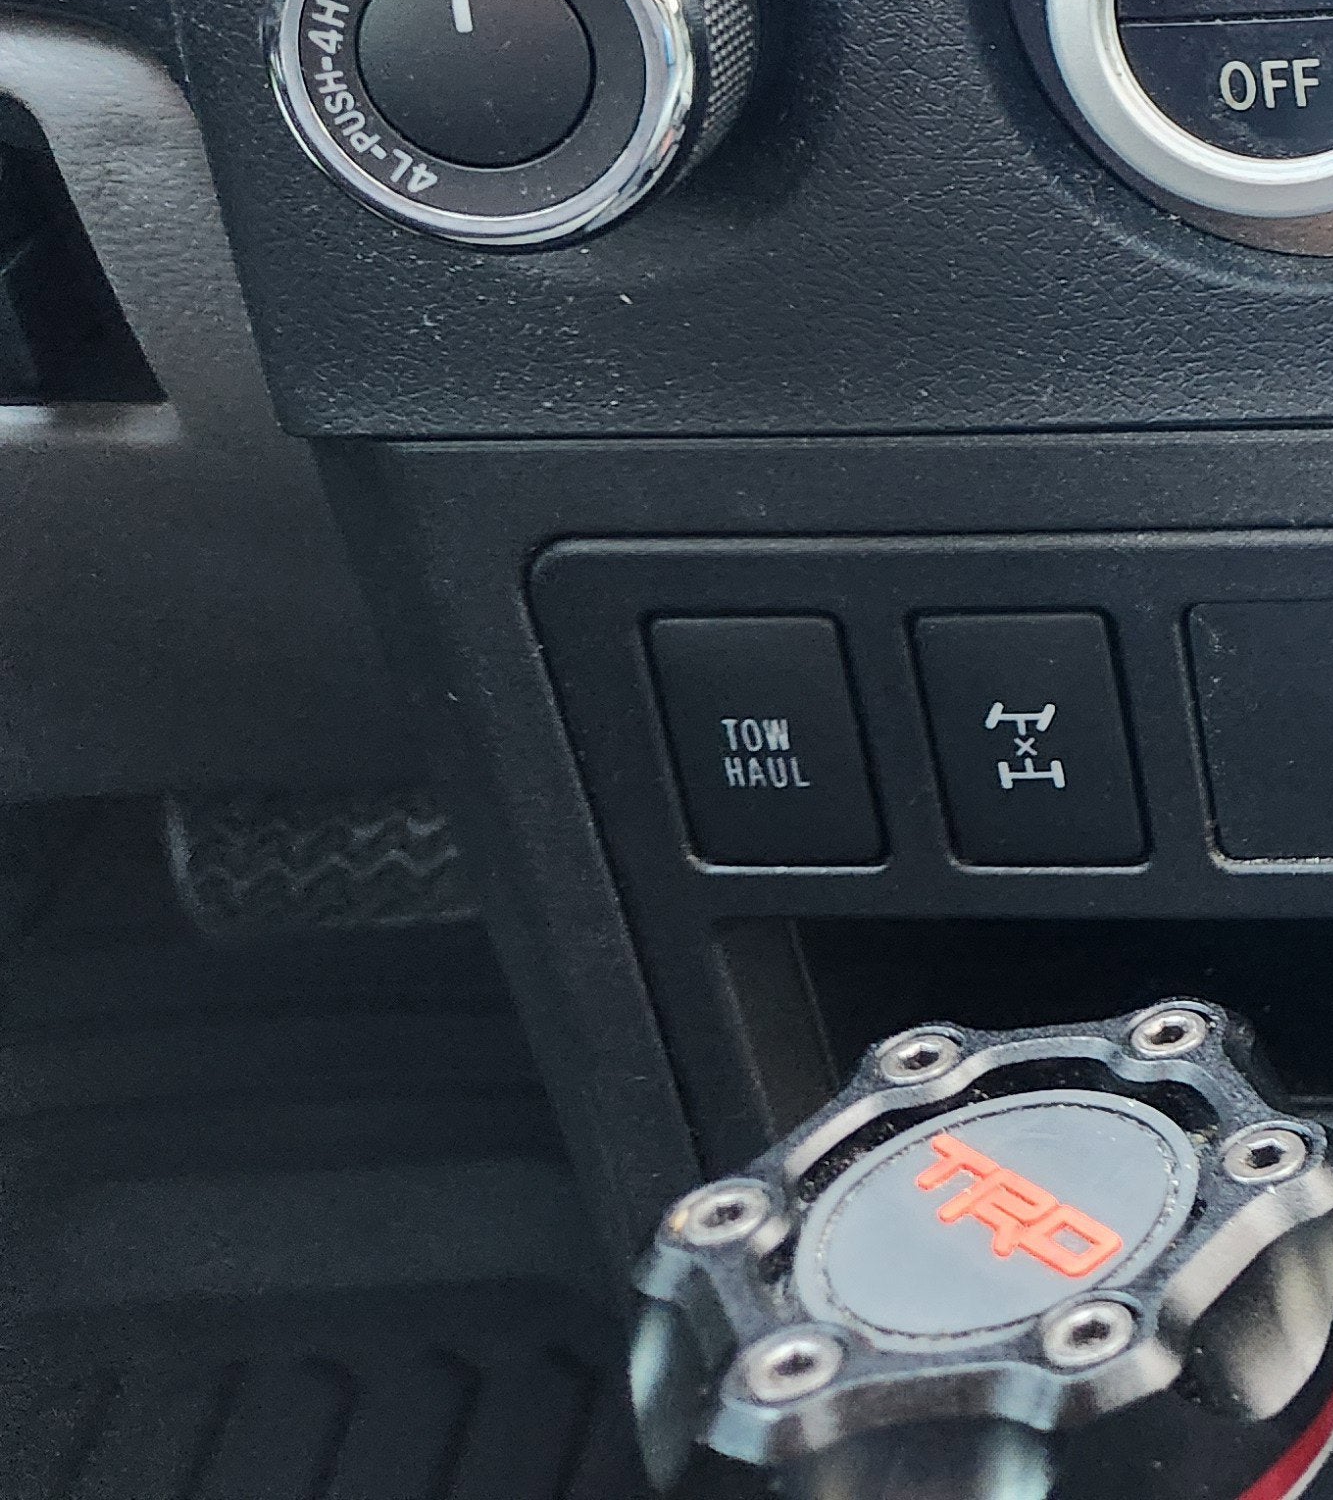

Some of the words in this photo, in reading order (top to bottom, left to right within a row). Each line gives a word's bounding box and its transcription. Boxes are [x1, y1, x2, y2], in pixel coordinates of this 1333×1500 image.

[1219, 58, 1320, 111] OFF
[721, 718, 790, 752] TOW
[724, 756, 811, 789] HAUL
[915, 1133, 1122, 1278] TRD
